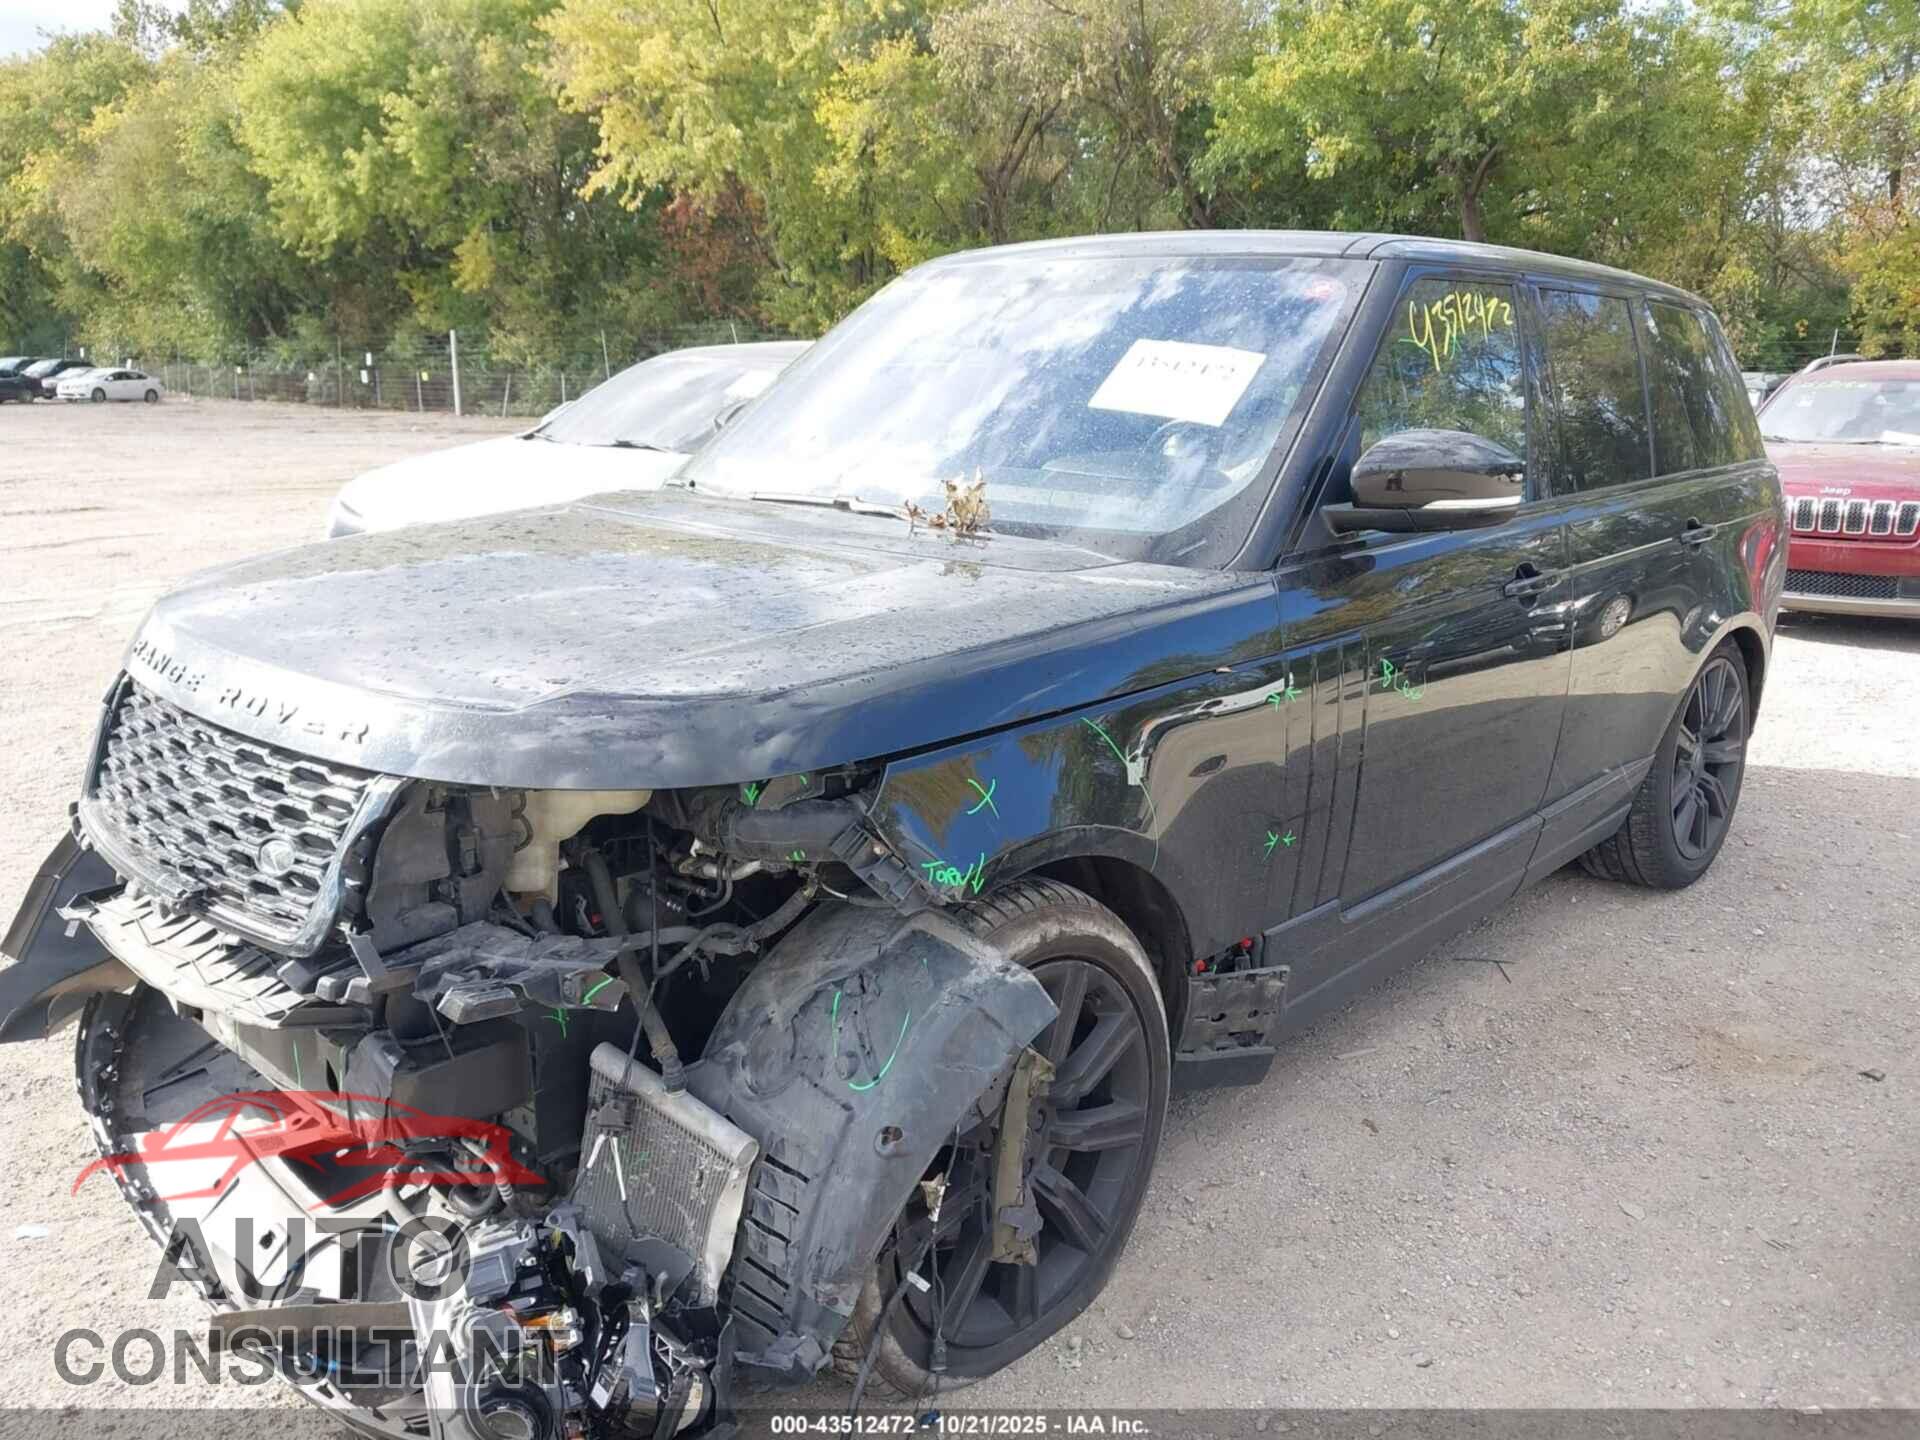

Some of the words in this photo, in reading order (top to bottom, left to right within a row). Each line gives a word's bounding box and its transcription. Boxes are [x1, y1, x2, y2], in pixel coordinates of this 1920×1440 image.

[1408, 290, 1514, 372] 43512472
[1819, 485, 1852, 496] Jeep
[133, 640, 206, 692] RANGE
[219, 688, 369, 745] ROVER
